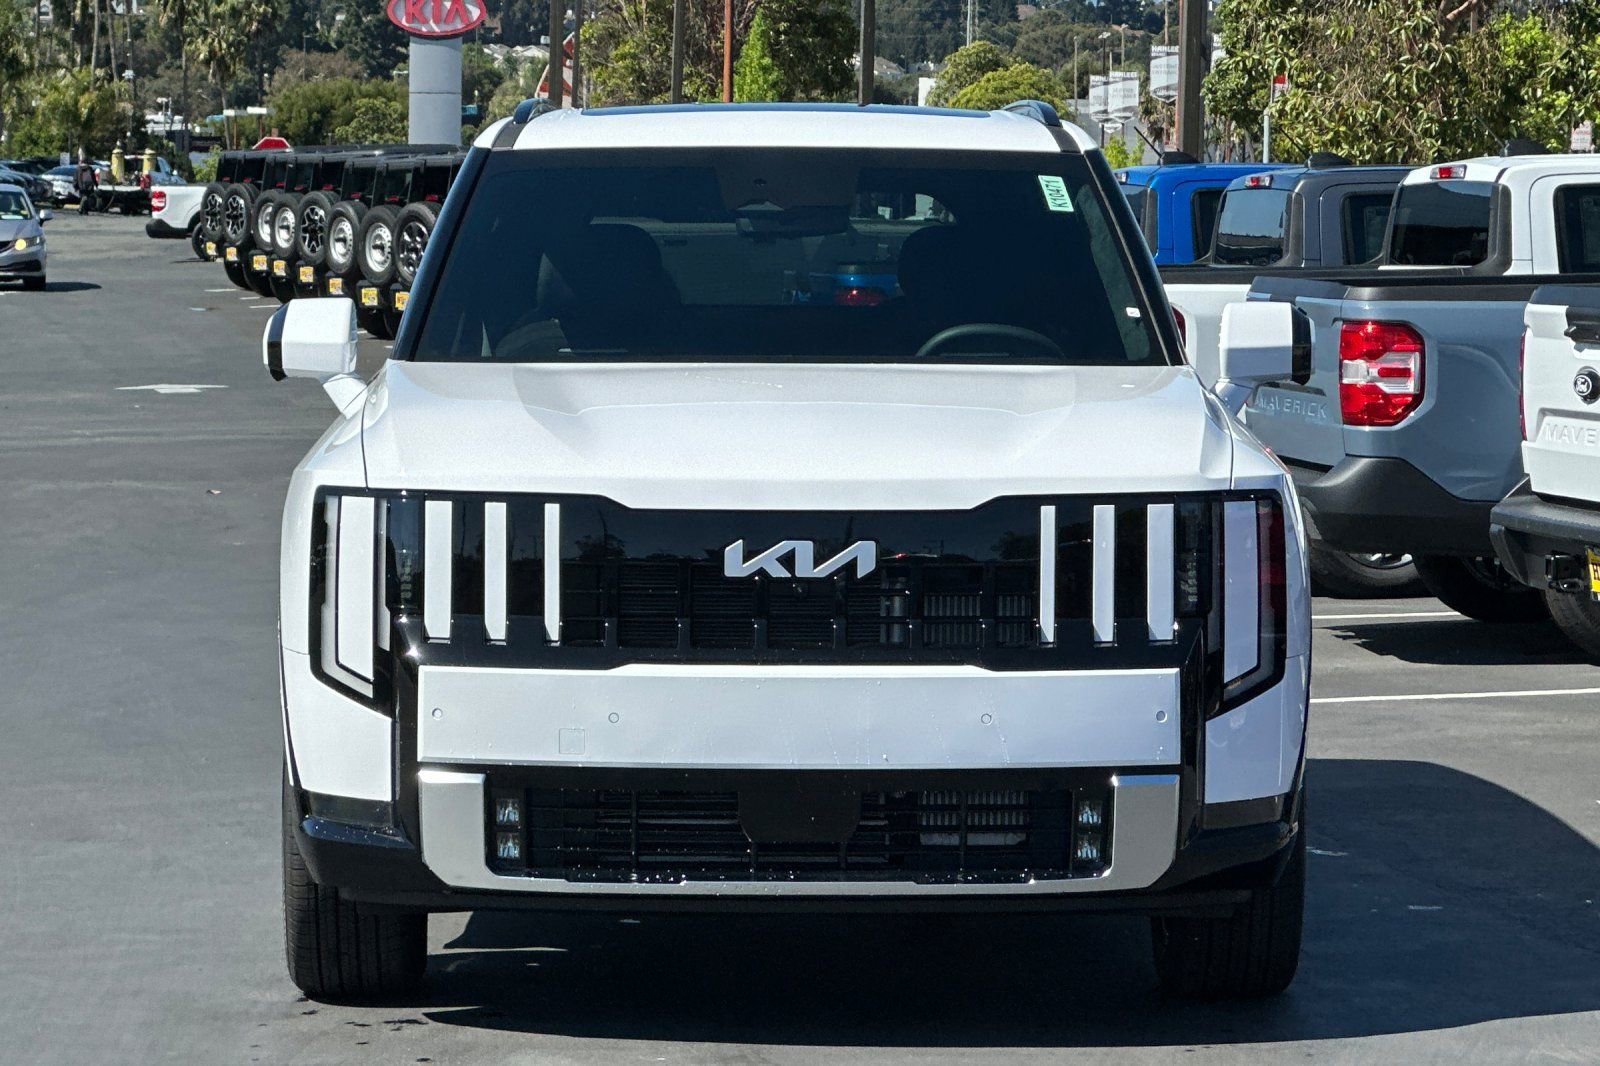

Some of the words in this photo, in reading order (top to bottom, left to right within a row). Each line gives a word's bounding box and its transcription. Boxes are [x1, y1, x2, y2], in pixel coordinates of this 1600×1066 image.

[404, 0, 470, 25] KIA
[1043, 180, 1070, 208] K10471
[1254, 394, 1327, 419] MAVERICK
[1543, 422, 1600, 448] MAVE
[724, 539, 877, 579] KIA
